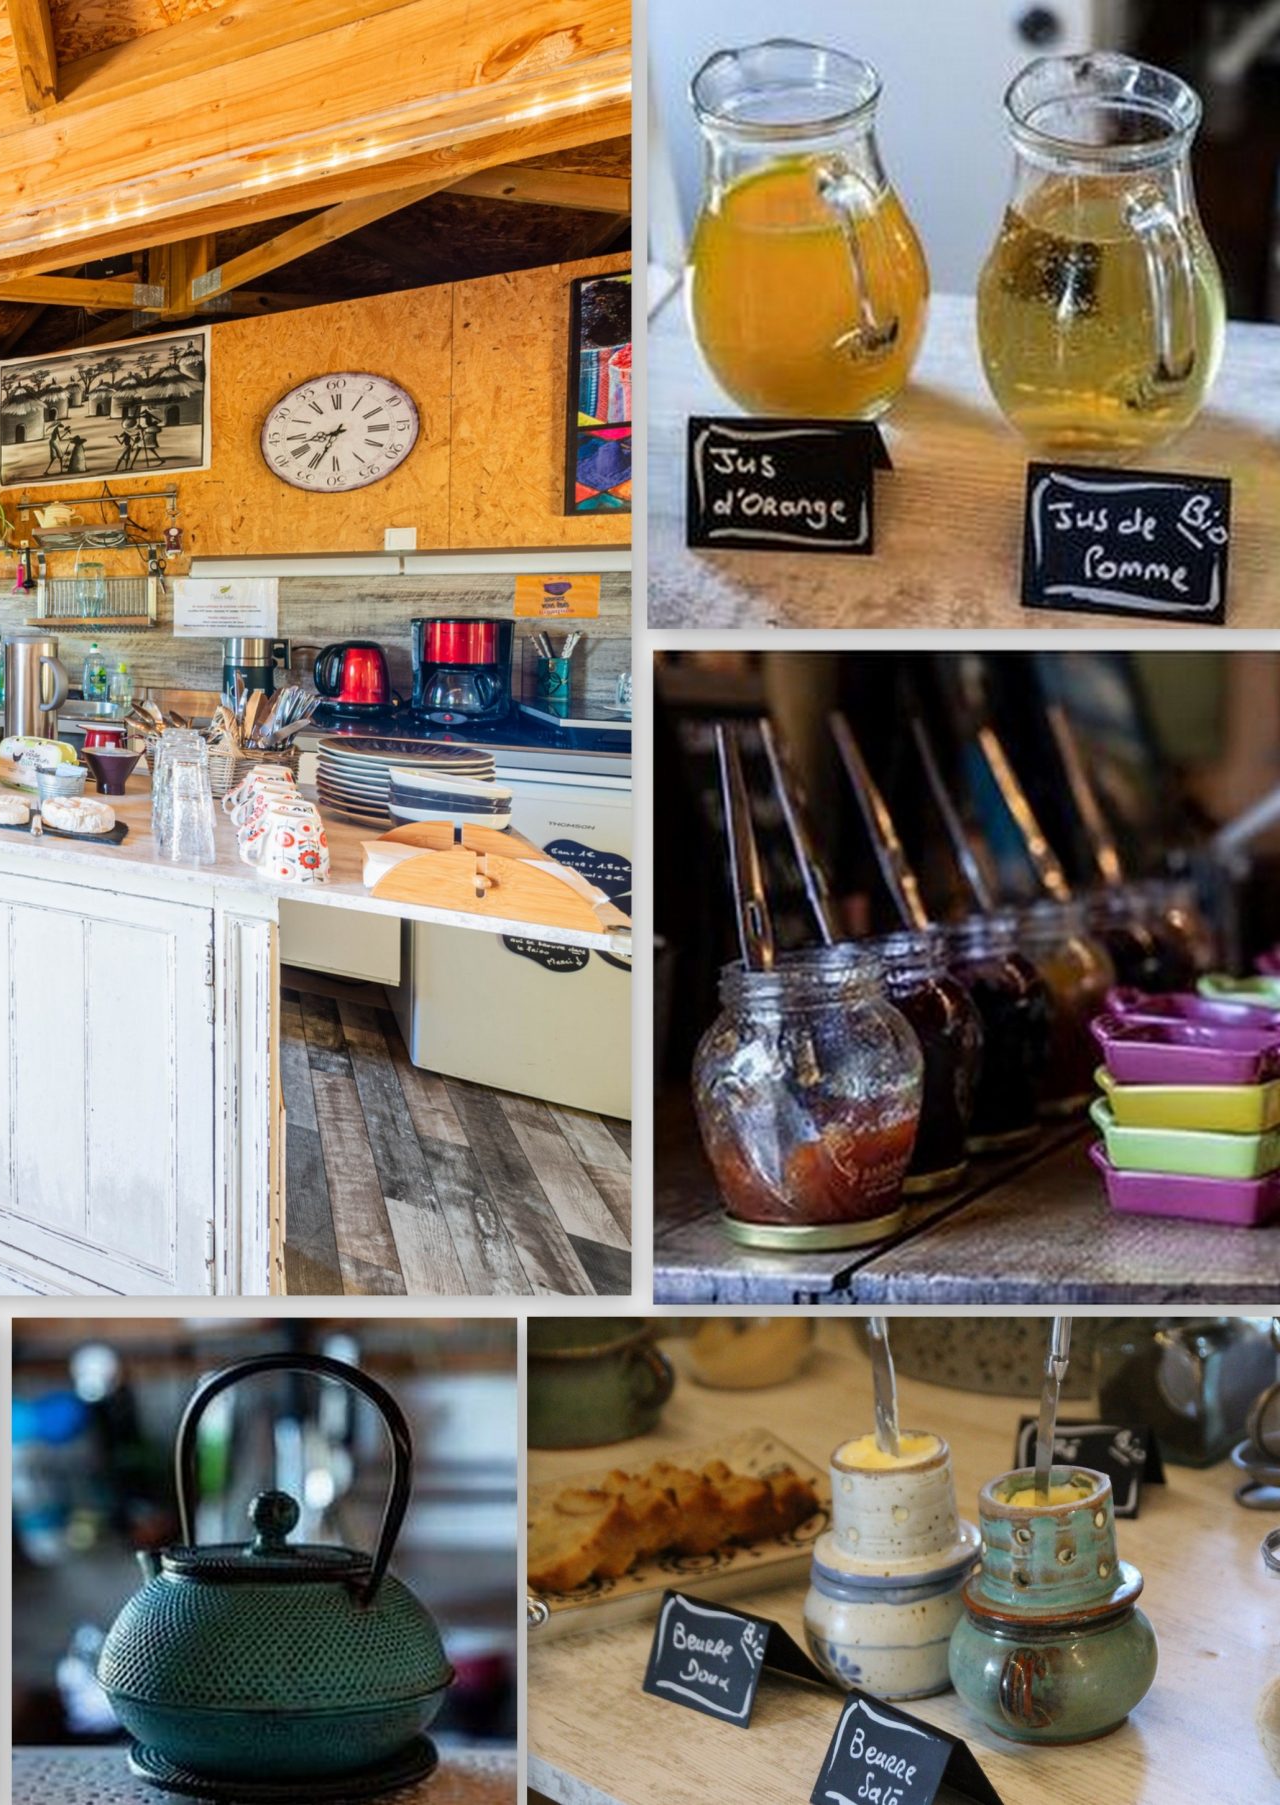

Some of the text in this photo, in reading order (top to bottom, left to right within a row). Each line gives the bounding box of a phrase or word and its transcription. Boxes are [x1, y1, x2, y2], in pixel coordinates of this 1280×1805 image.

[326, 378, 346, 390] 60
[364, 381, 376, 392] 5
[296, 388, 315, 402] 55
[386, 395, 402, 408] 10
[274, 407, 291, 423] 50
[396, 418, 410, 432] 15
[268, 432, 281, 448] 45
[385, 442, 404, 460] 20
[274, 454, 290, 469] 40
[708, 447, 776, 479] Jus
[358, 463, 380, 480] 25
[326, 474, 348, 487] 30
[1048, 494, 1229, 544] Jus de Bio
[1084, 545, 1190, 592] Pomme
[548, 821, 596, 831] THOMSON
[679, 1658, 730, 1692] Doux
